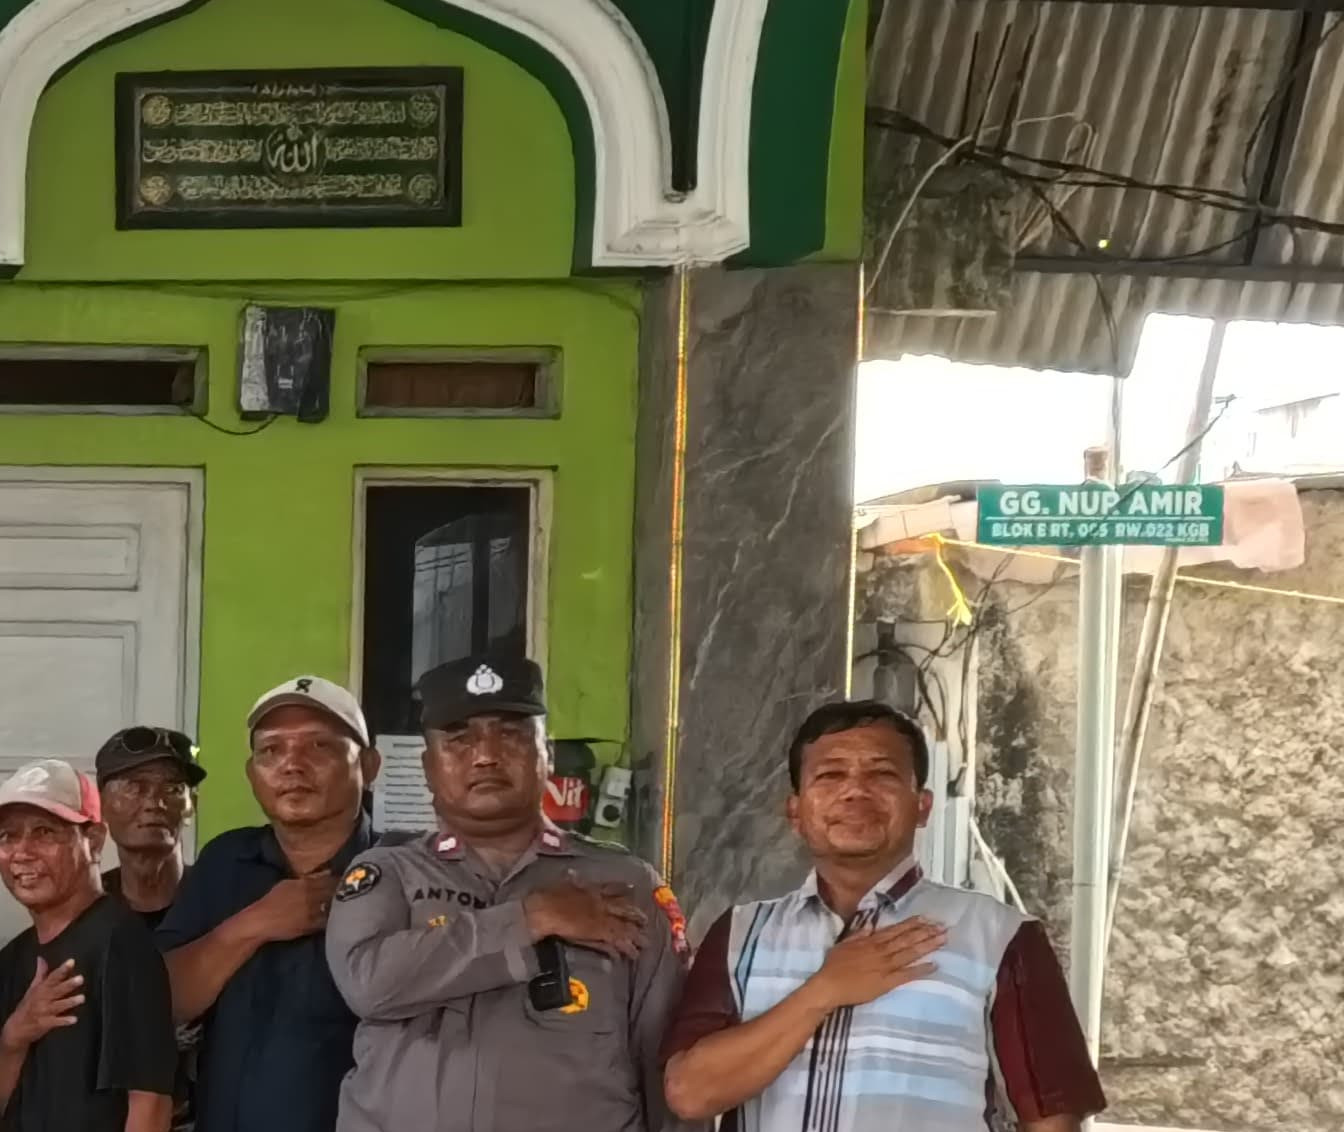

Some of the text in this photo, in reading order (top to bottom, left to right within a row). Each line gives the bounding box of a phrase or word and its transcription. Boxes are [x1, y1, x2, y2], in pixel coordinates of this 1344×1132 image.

[1000, 490, 1050, 516] GG.
[1128, 490, 1203, 516] AMIR
[545, 776, 584, 809] Vit
